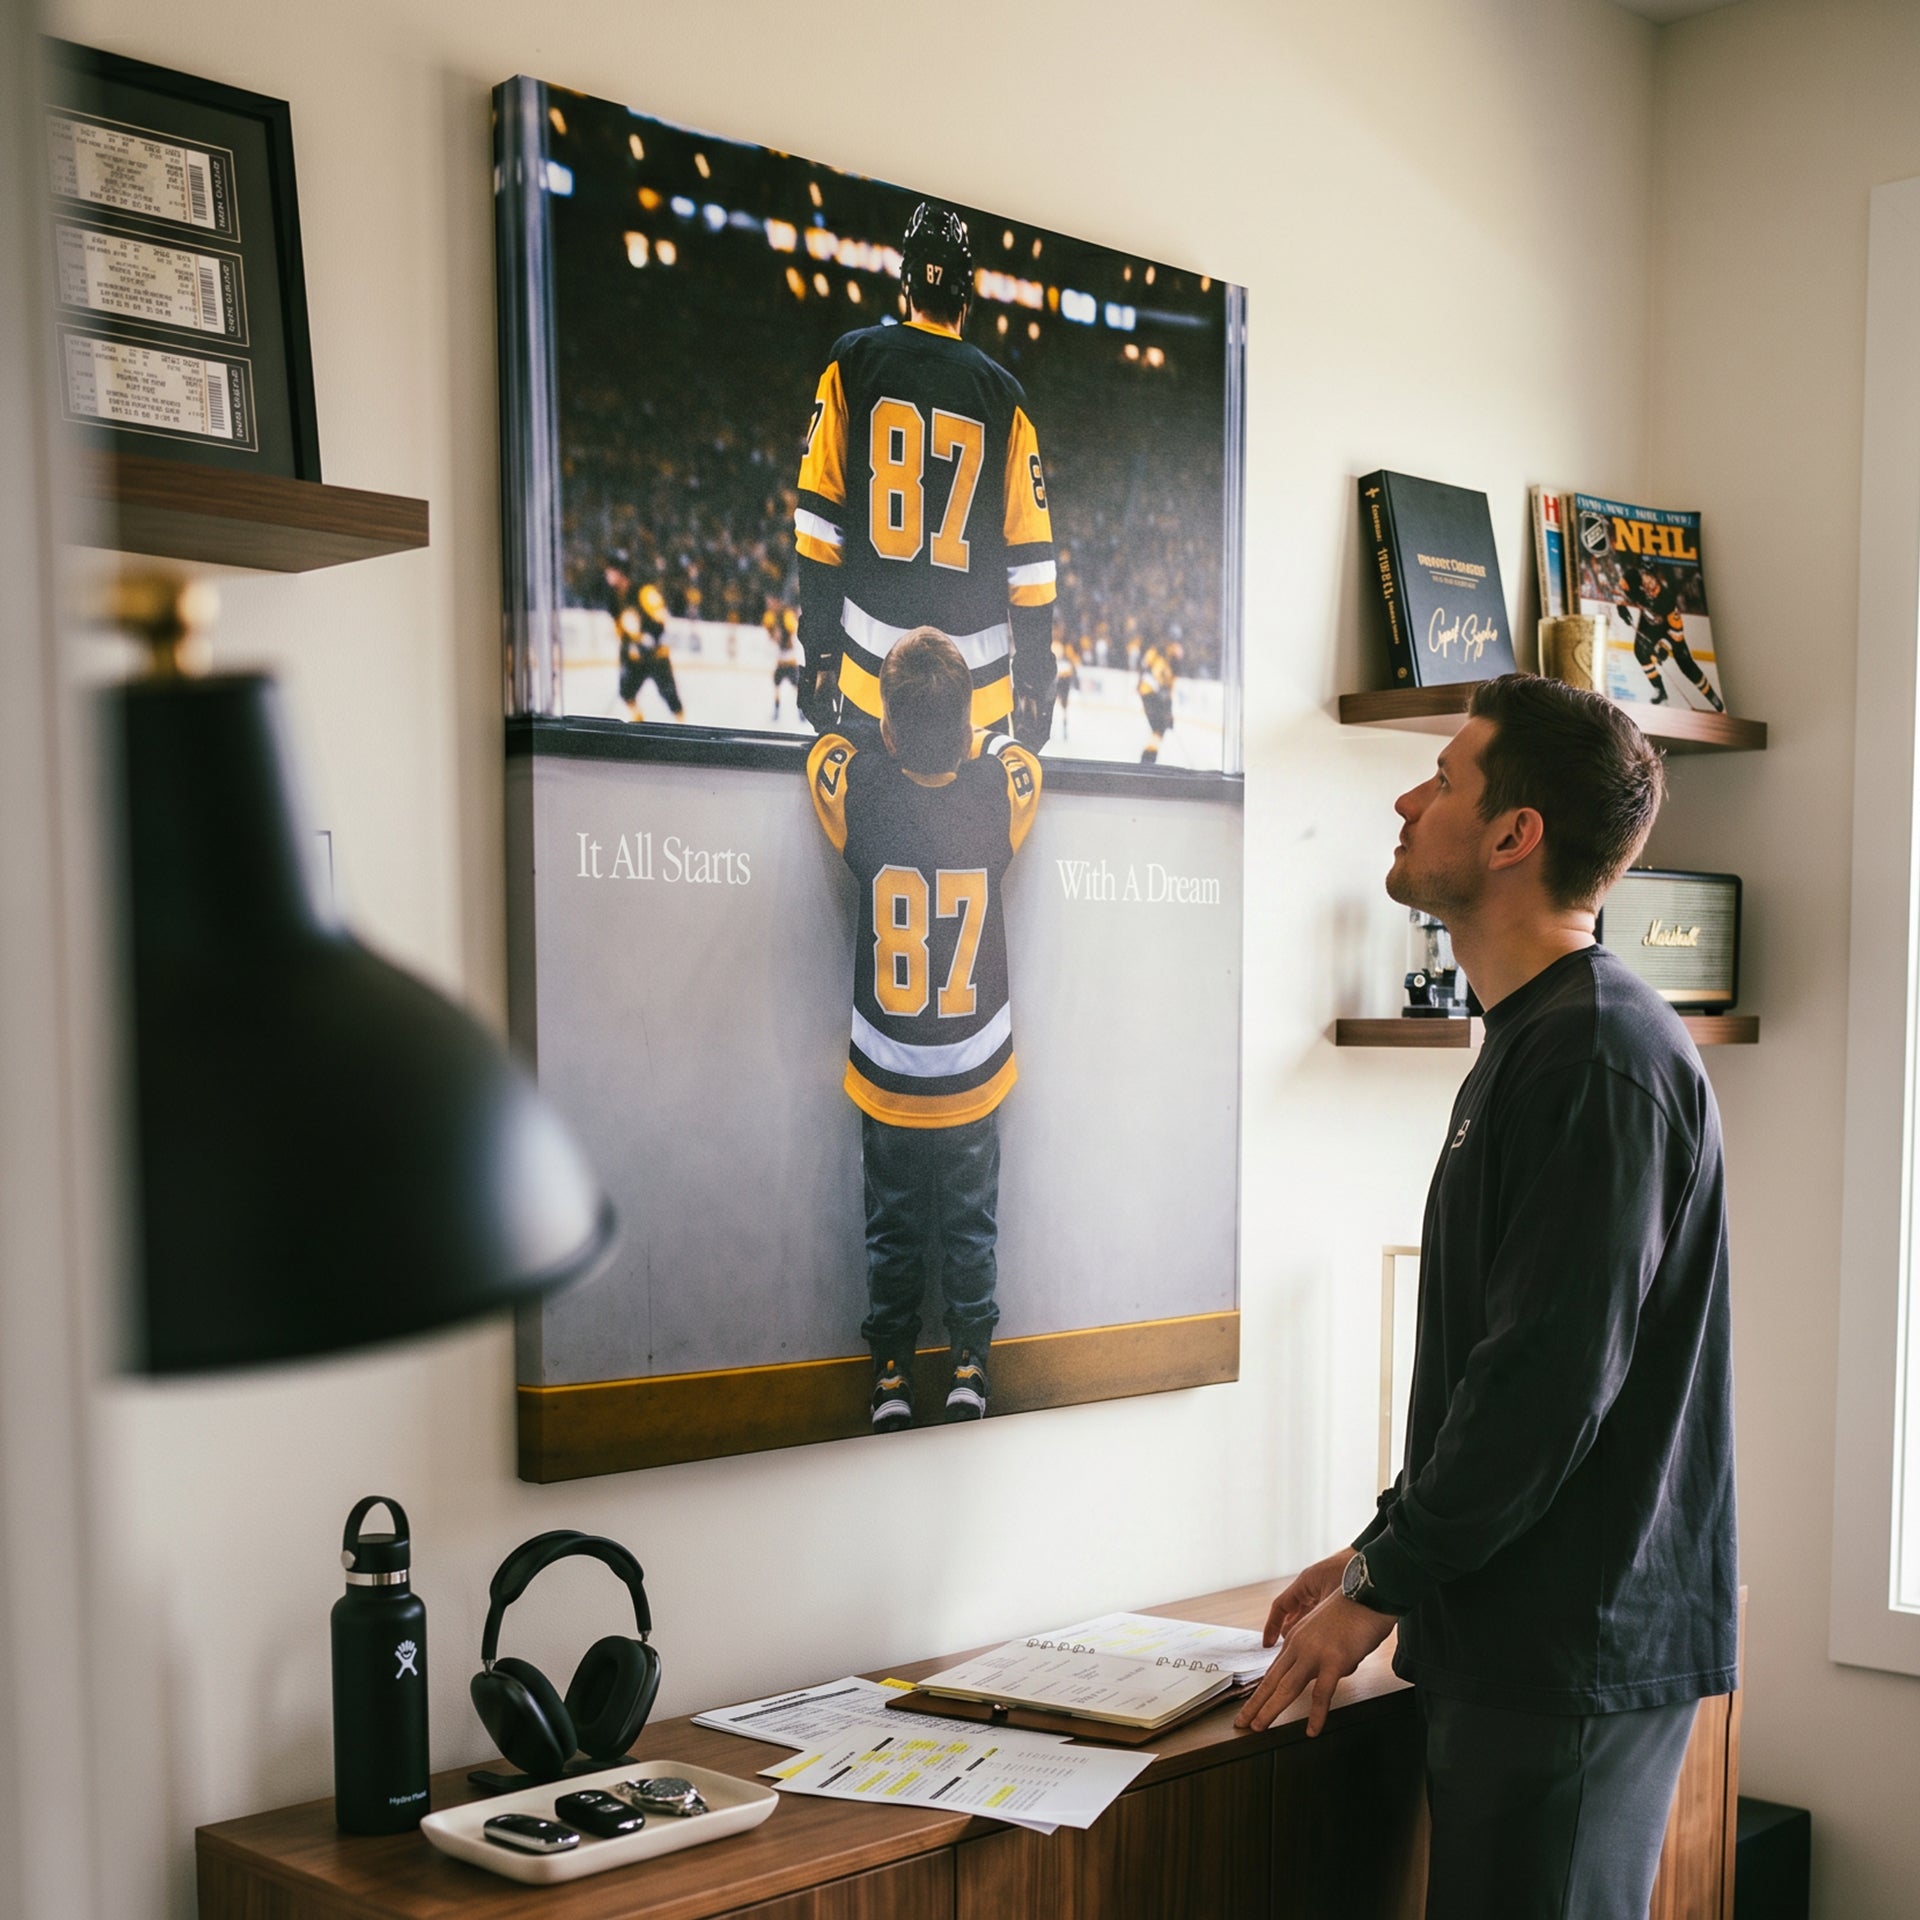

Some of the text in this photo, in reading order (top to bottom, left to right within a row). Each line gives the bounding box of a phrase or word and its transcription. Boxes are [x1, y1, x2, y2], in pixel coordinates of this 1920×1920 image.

[926, 263, 943, 286] 87
[869, 396, 985, 572] 87
[1611, 517, 1697, 560] NHL
[576, 831, 751, 885] It All Starts
[1056, 860, 1220, 905] With A Dream
[872, 864, 988, 1018] 87
